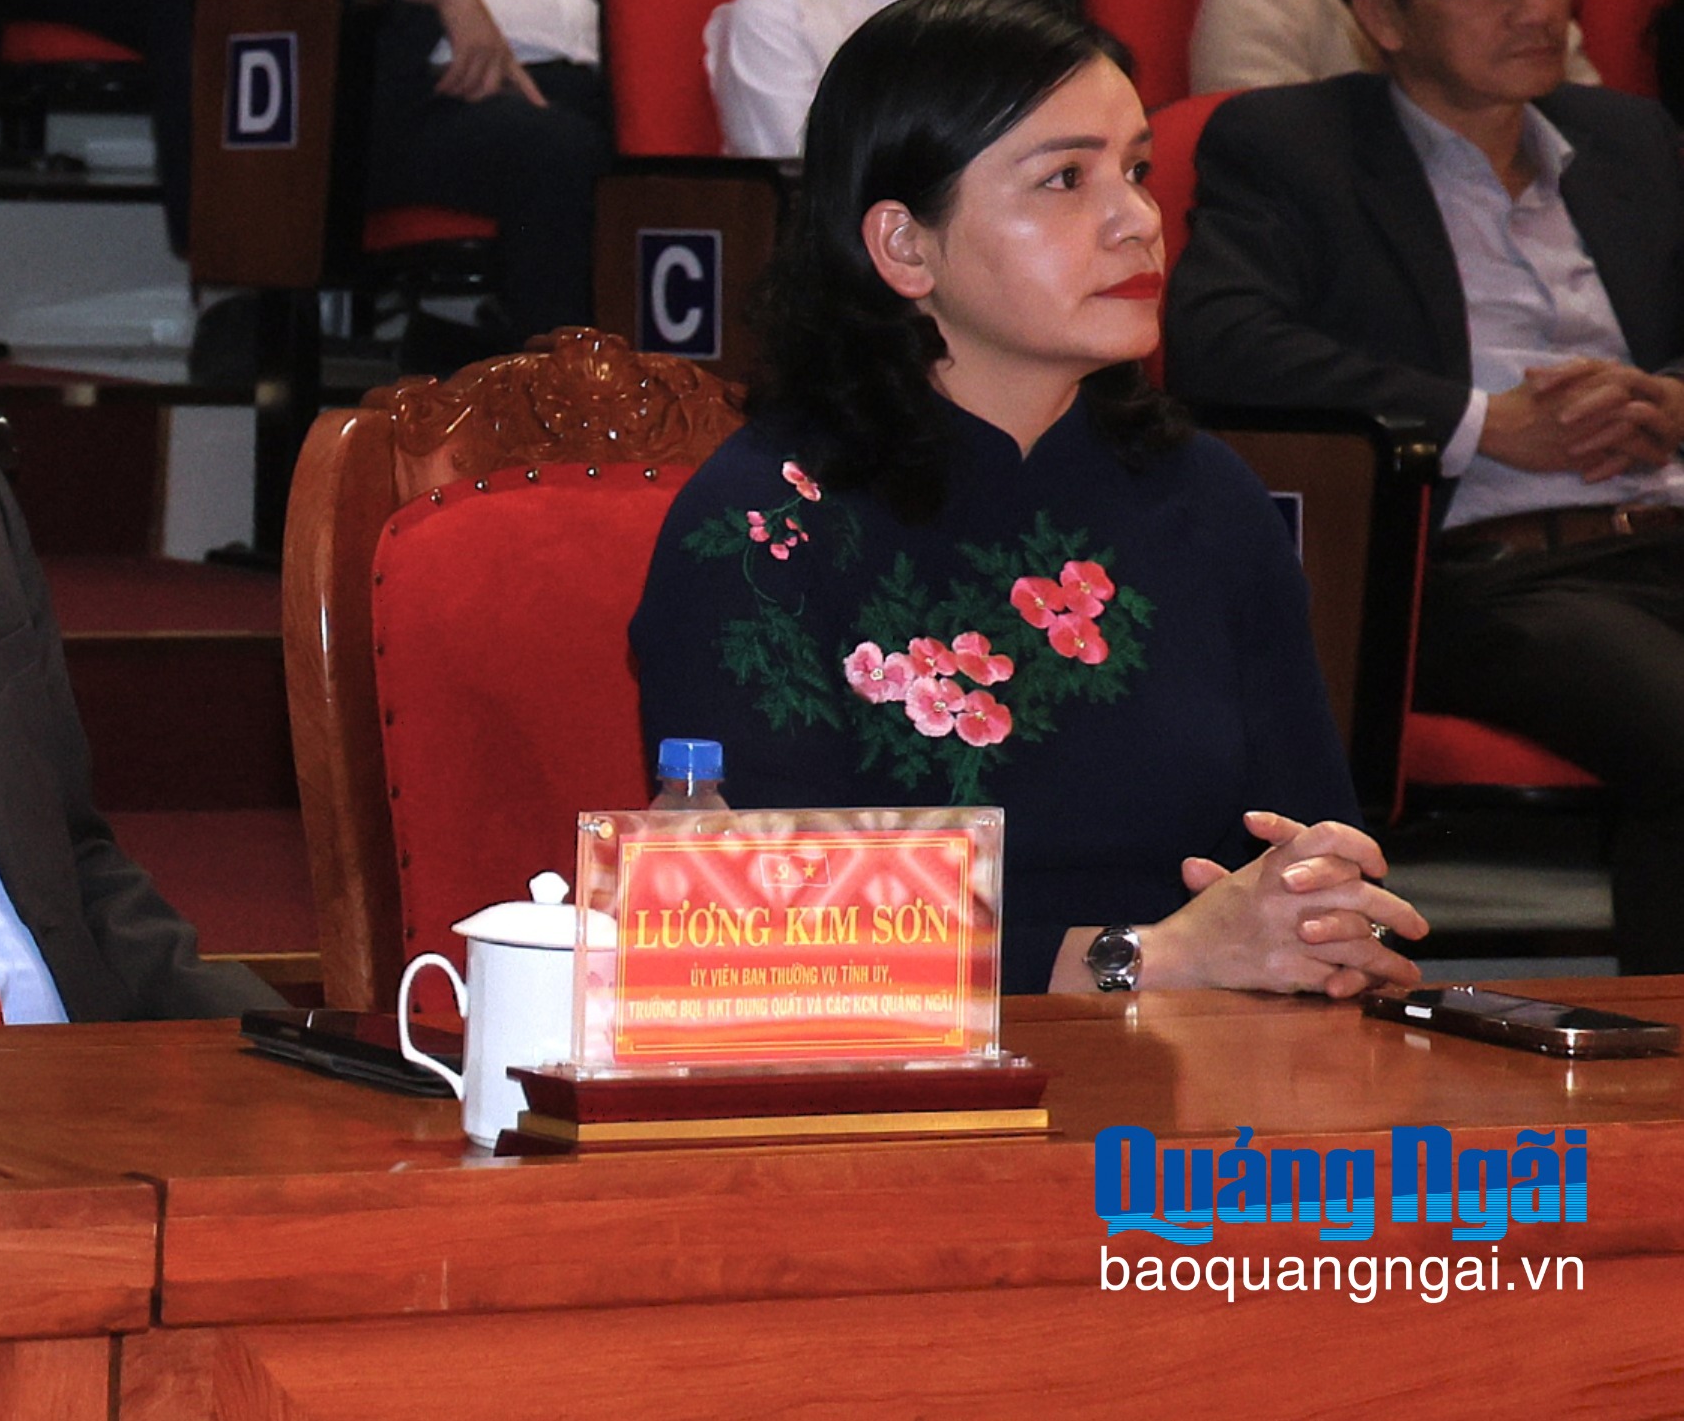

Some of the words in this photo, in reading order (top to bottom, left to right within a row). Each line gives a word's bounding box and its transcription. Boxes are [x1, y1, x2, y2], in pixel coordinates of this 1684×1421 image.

[237, 49, 283, 134] D
[650, 244, 703, 344] C
[634, 899, 771, 949] LƯƠNG
[784, 905, 860, 946] KIM
[871, 898, 950, 944] SƠN
[741, 967, 767, 986] BAN
[735, 996, 769, 1017] DUNG
